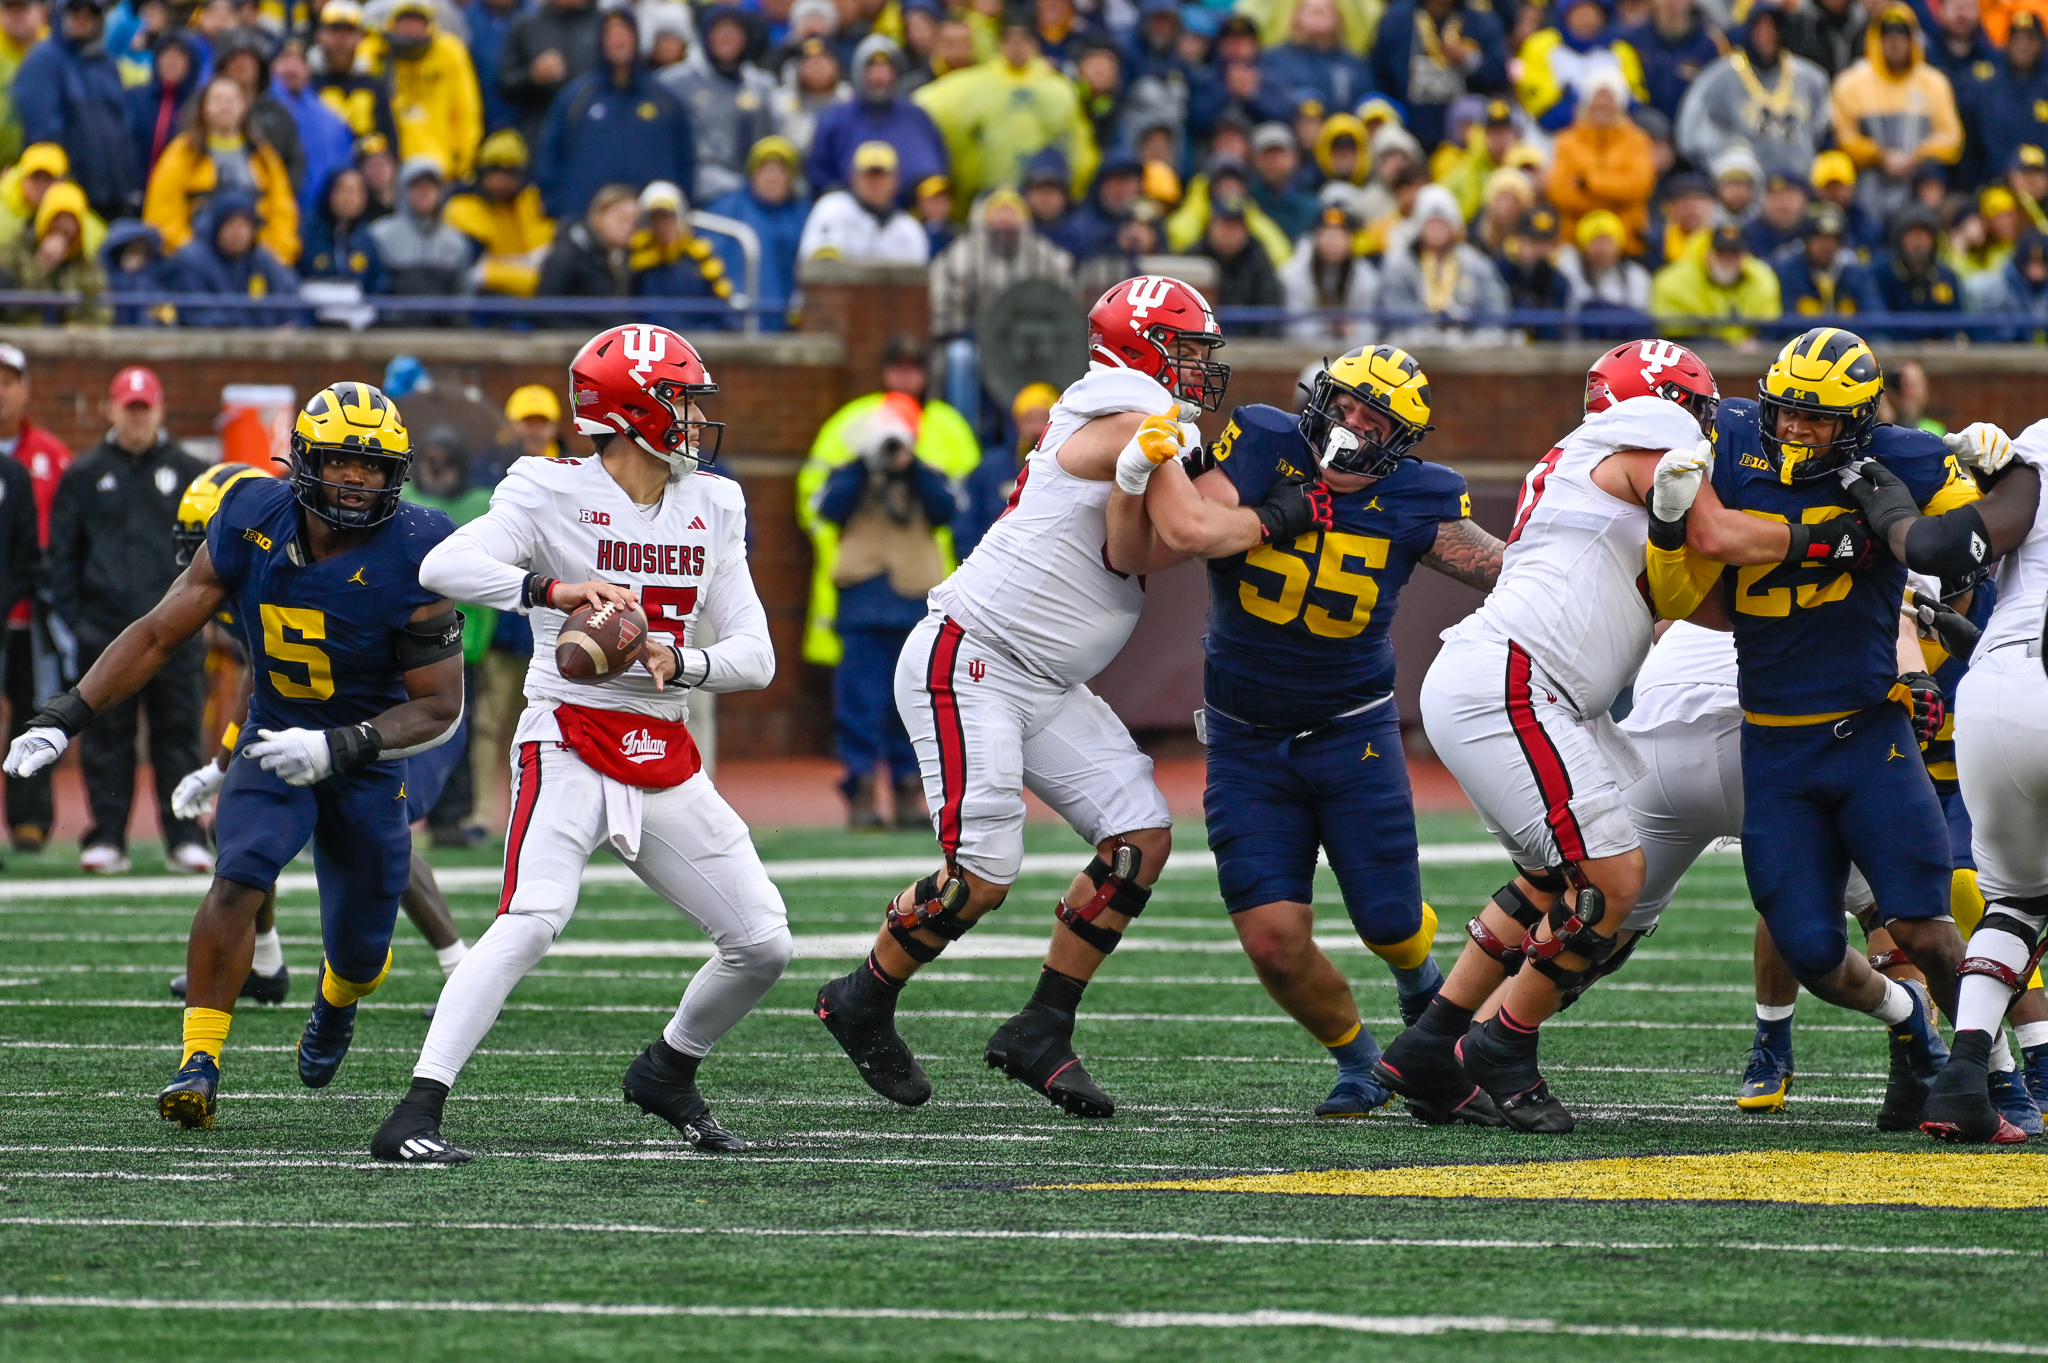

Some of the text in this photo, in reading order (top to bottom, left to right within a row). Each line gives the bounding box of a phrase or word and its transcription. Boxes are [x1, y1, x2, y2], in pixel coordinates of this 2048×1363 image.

[1793, 389, 1806, 400] M
[358, 435, 371, 446] M
[596, 539, 706, 577] HOOSIERS
[1239, 529, 1391, 639] 55
[259, 603, 335, 701] 5
